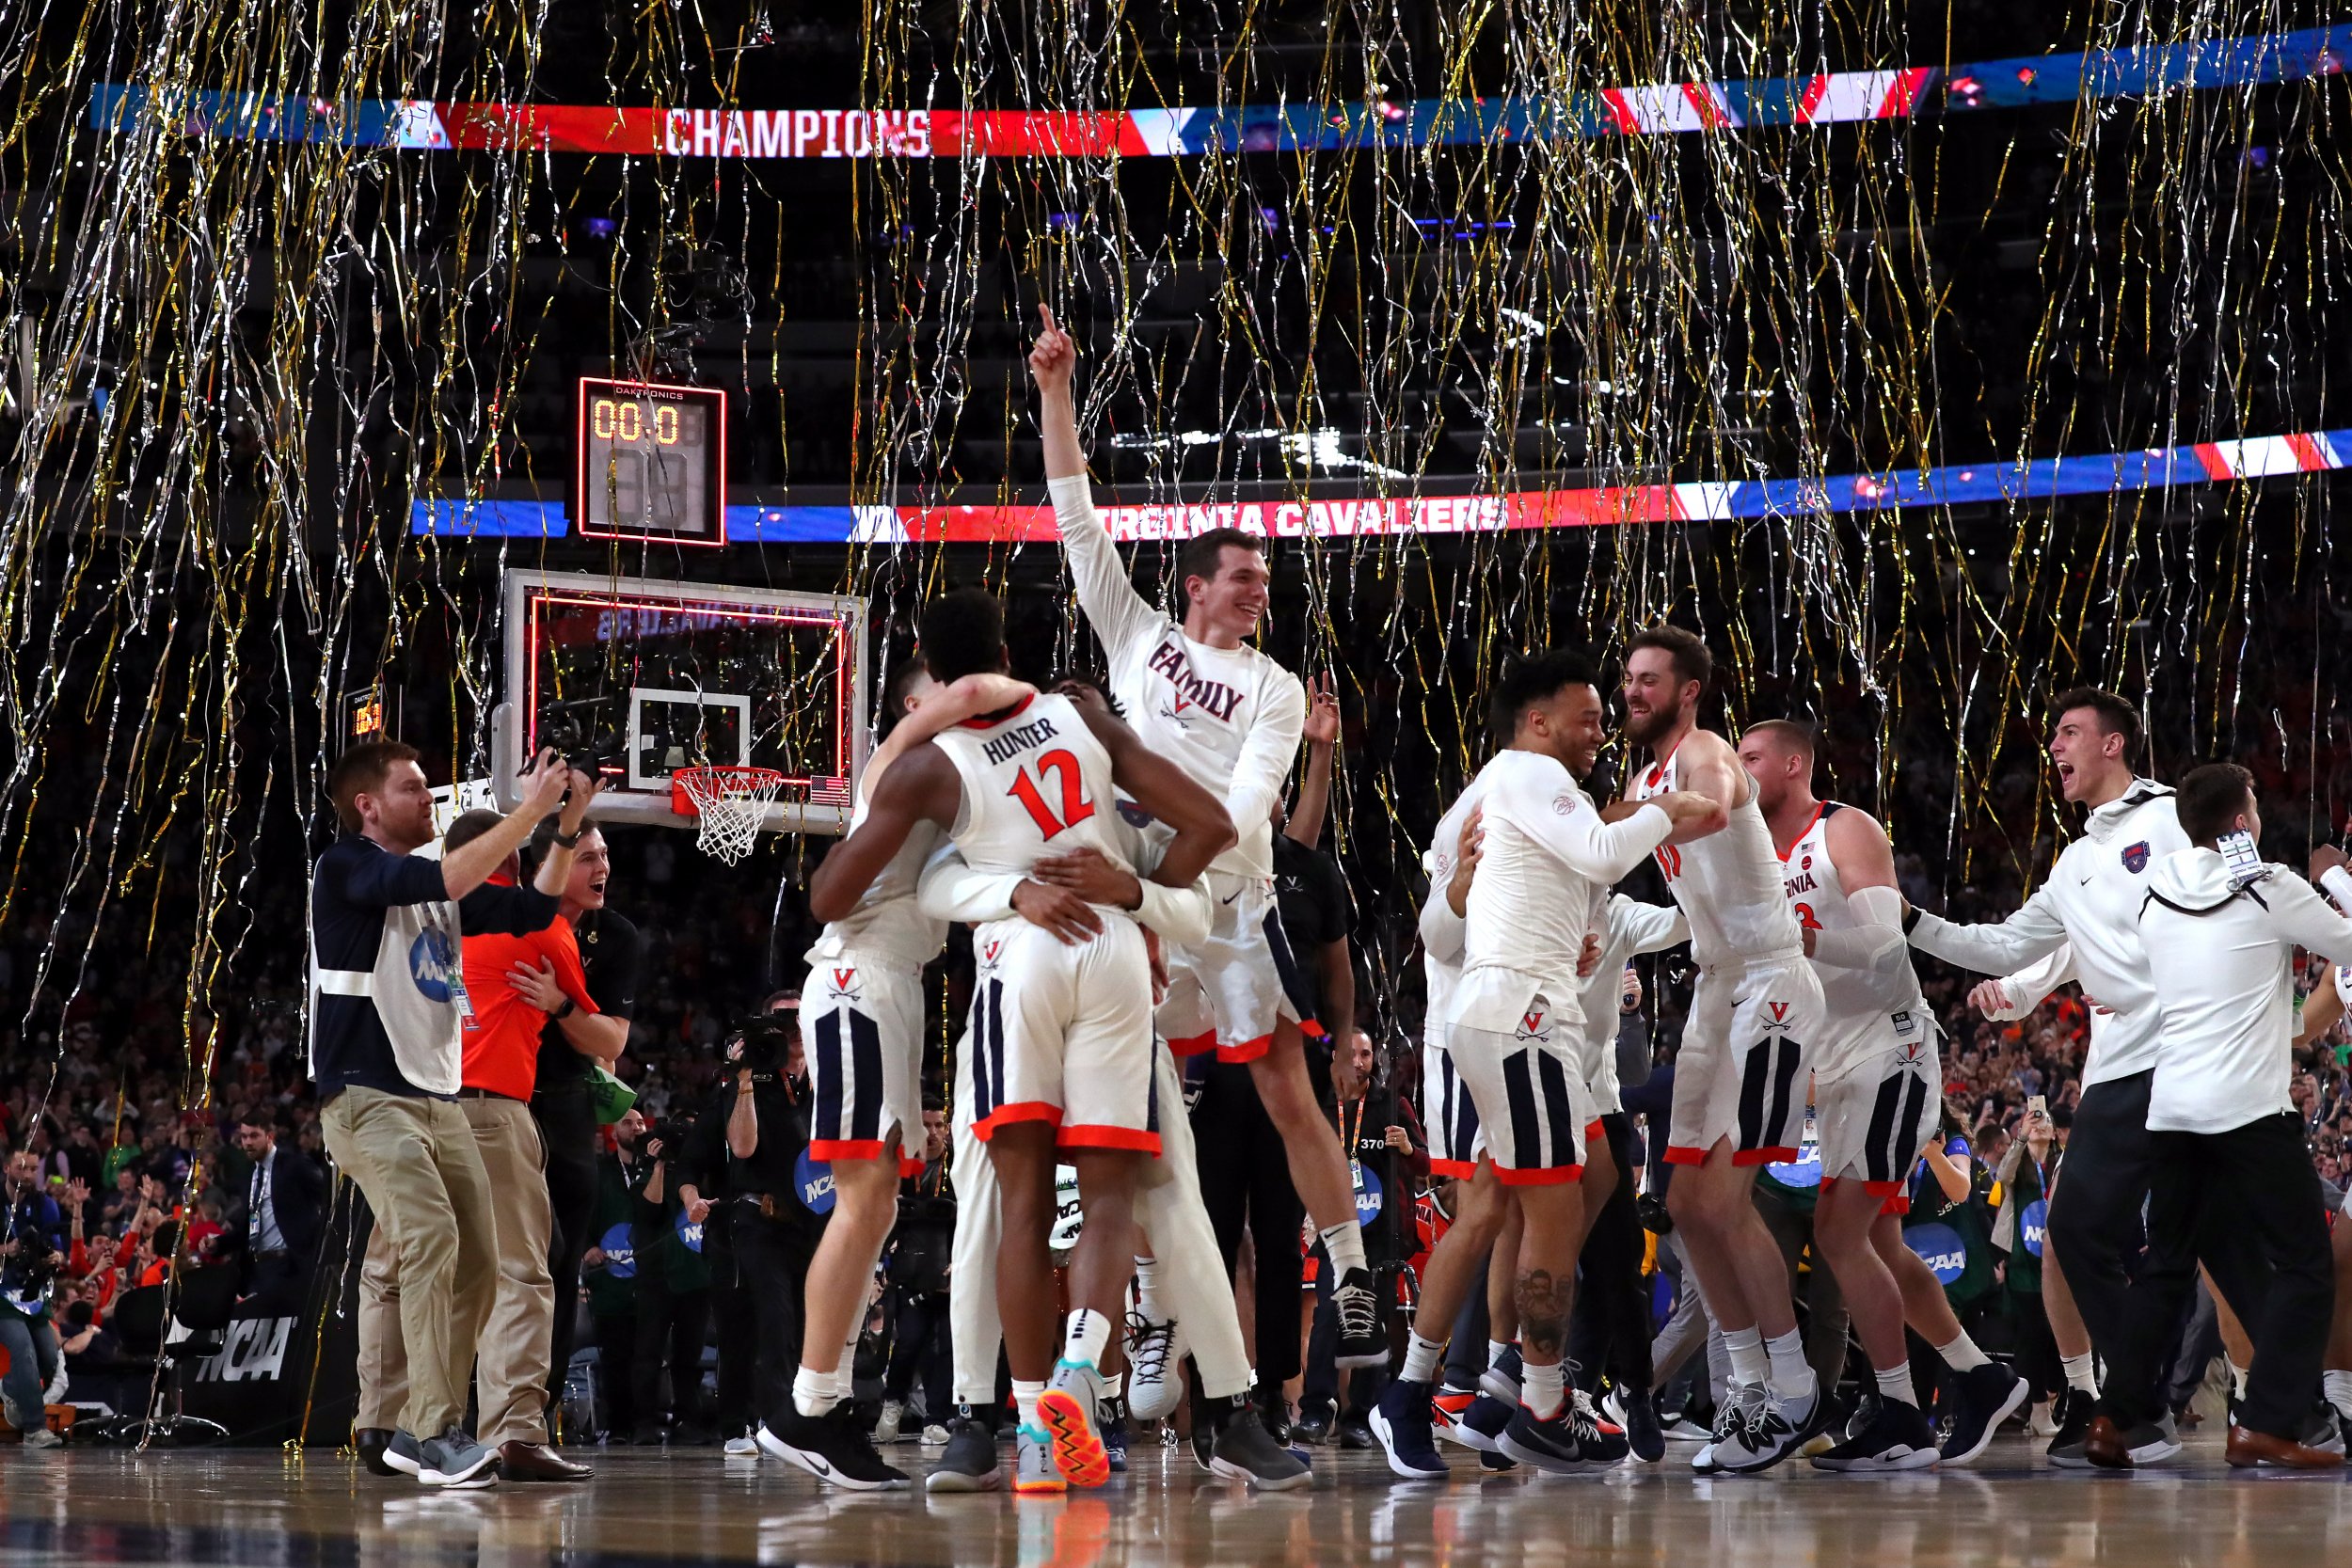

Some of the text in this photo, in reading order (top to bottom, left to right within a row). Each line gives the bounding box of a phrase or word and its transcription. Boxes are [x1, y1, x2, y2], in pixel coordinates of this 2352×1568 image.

[666, 109, 930, 157] CHAMPIONS
[616, 387, 684, 401] DAKTRONICS
[1096, 497, 1509, 541] IRGINIA CAVALIERS
[1148, 641, 1245, 722] FAMILY
[982, 718, 1059, 766] HUNTER
[1007, 749, 1095, 842] 12
[1360, 1138, 1385, 1149] 370
[195, 1317, 293, 1383] NCAA
